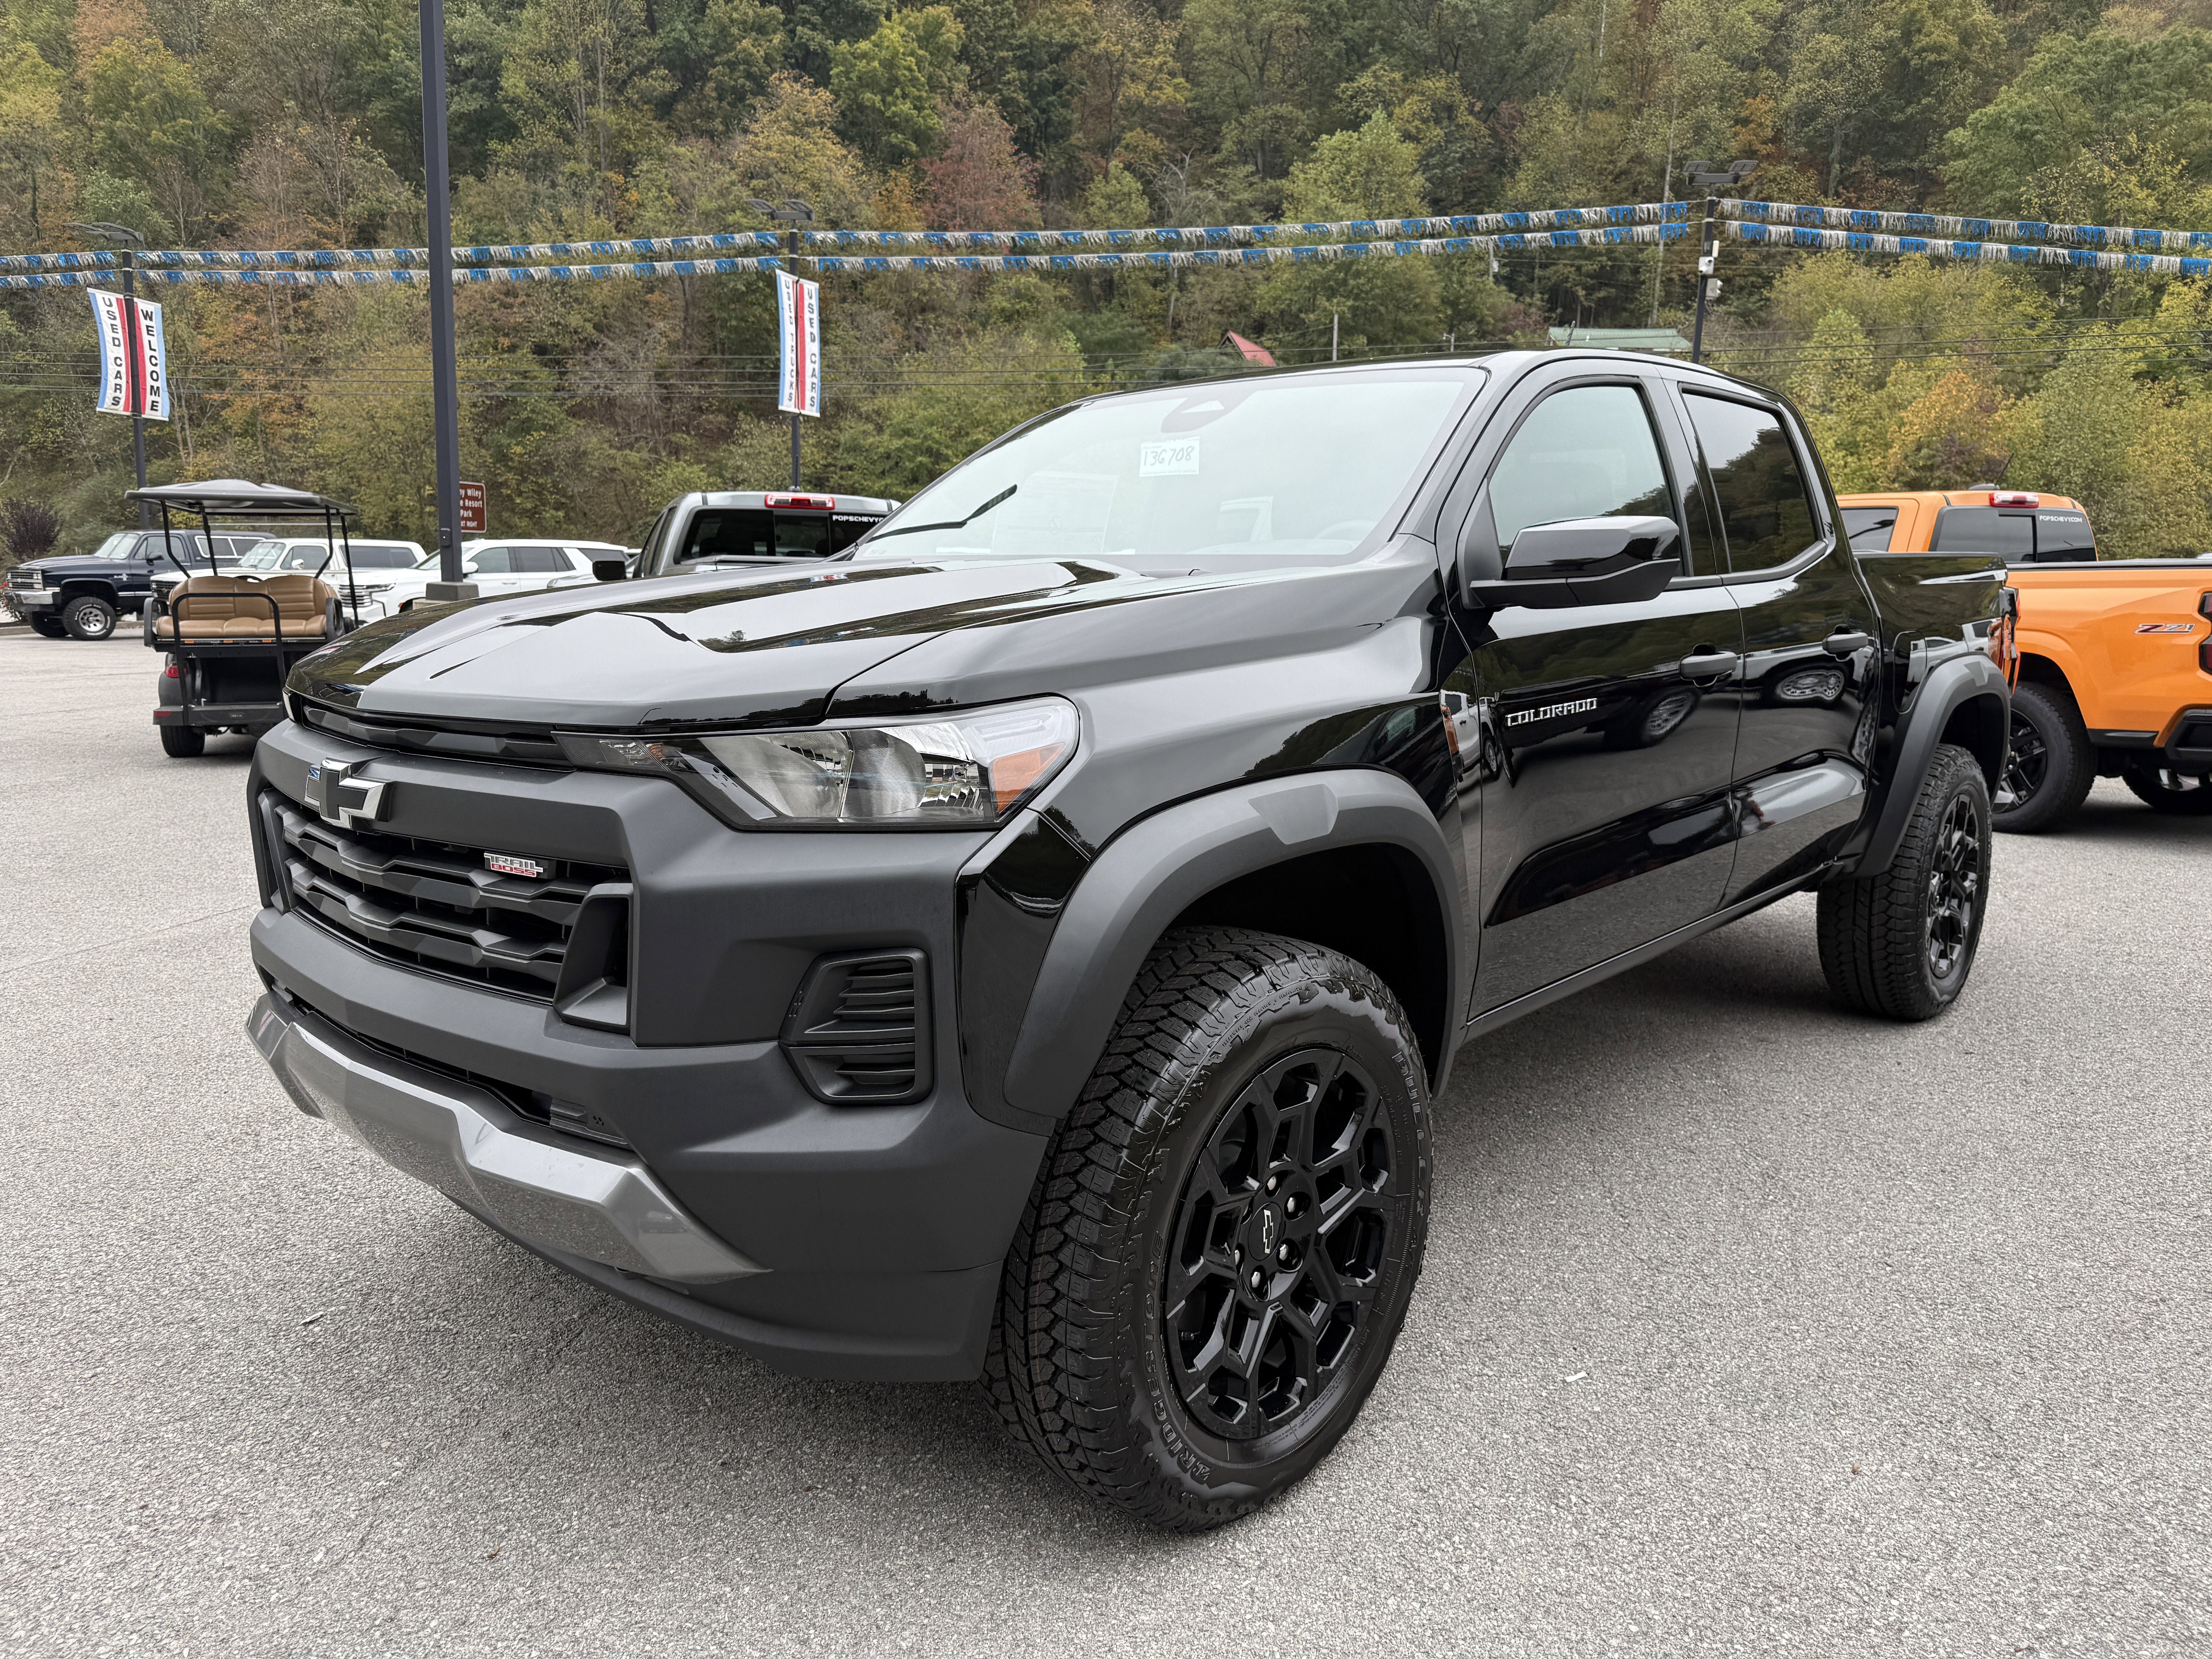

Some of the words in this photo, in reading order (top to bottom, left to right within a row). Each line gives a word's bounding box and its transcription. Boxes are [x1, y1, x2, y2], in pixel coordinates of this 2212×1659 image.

[785, 279, 793, 325] USED
[807, 288, 816, 343] USED
[101, 297, 121, 347] USED
[111, 356, 123, 406] CARS
[140, 308, 160, 412] WELCOME
[1144, 445, 1195, 466] 136708
[465, 499, 483, 508] Resort
[467, 488, 481, 499] Wiley
[460, 509, 472, 517] Park
[2134, 623, 2195, 634] Z71
[1505, 698, 1597, 726] COLORADO
[484, 852, 543, 872] TRAIL
[491, 863, 536, 877] BOSS
[1391, 1051, 1426, 1216] DUELER
[1144, 1231, 1211, 1484] BRIDGESTONE
